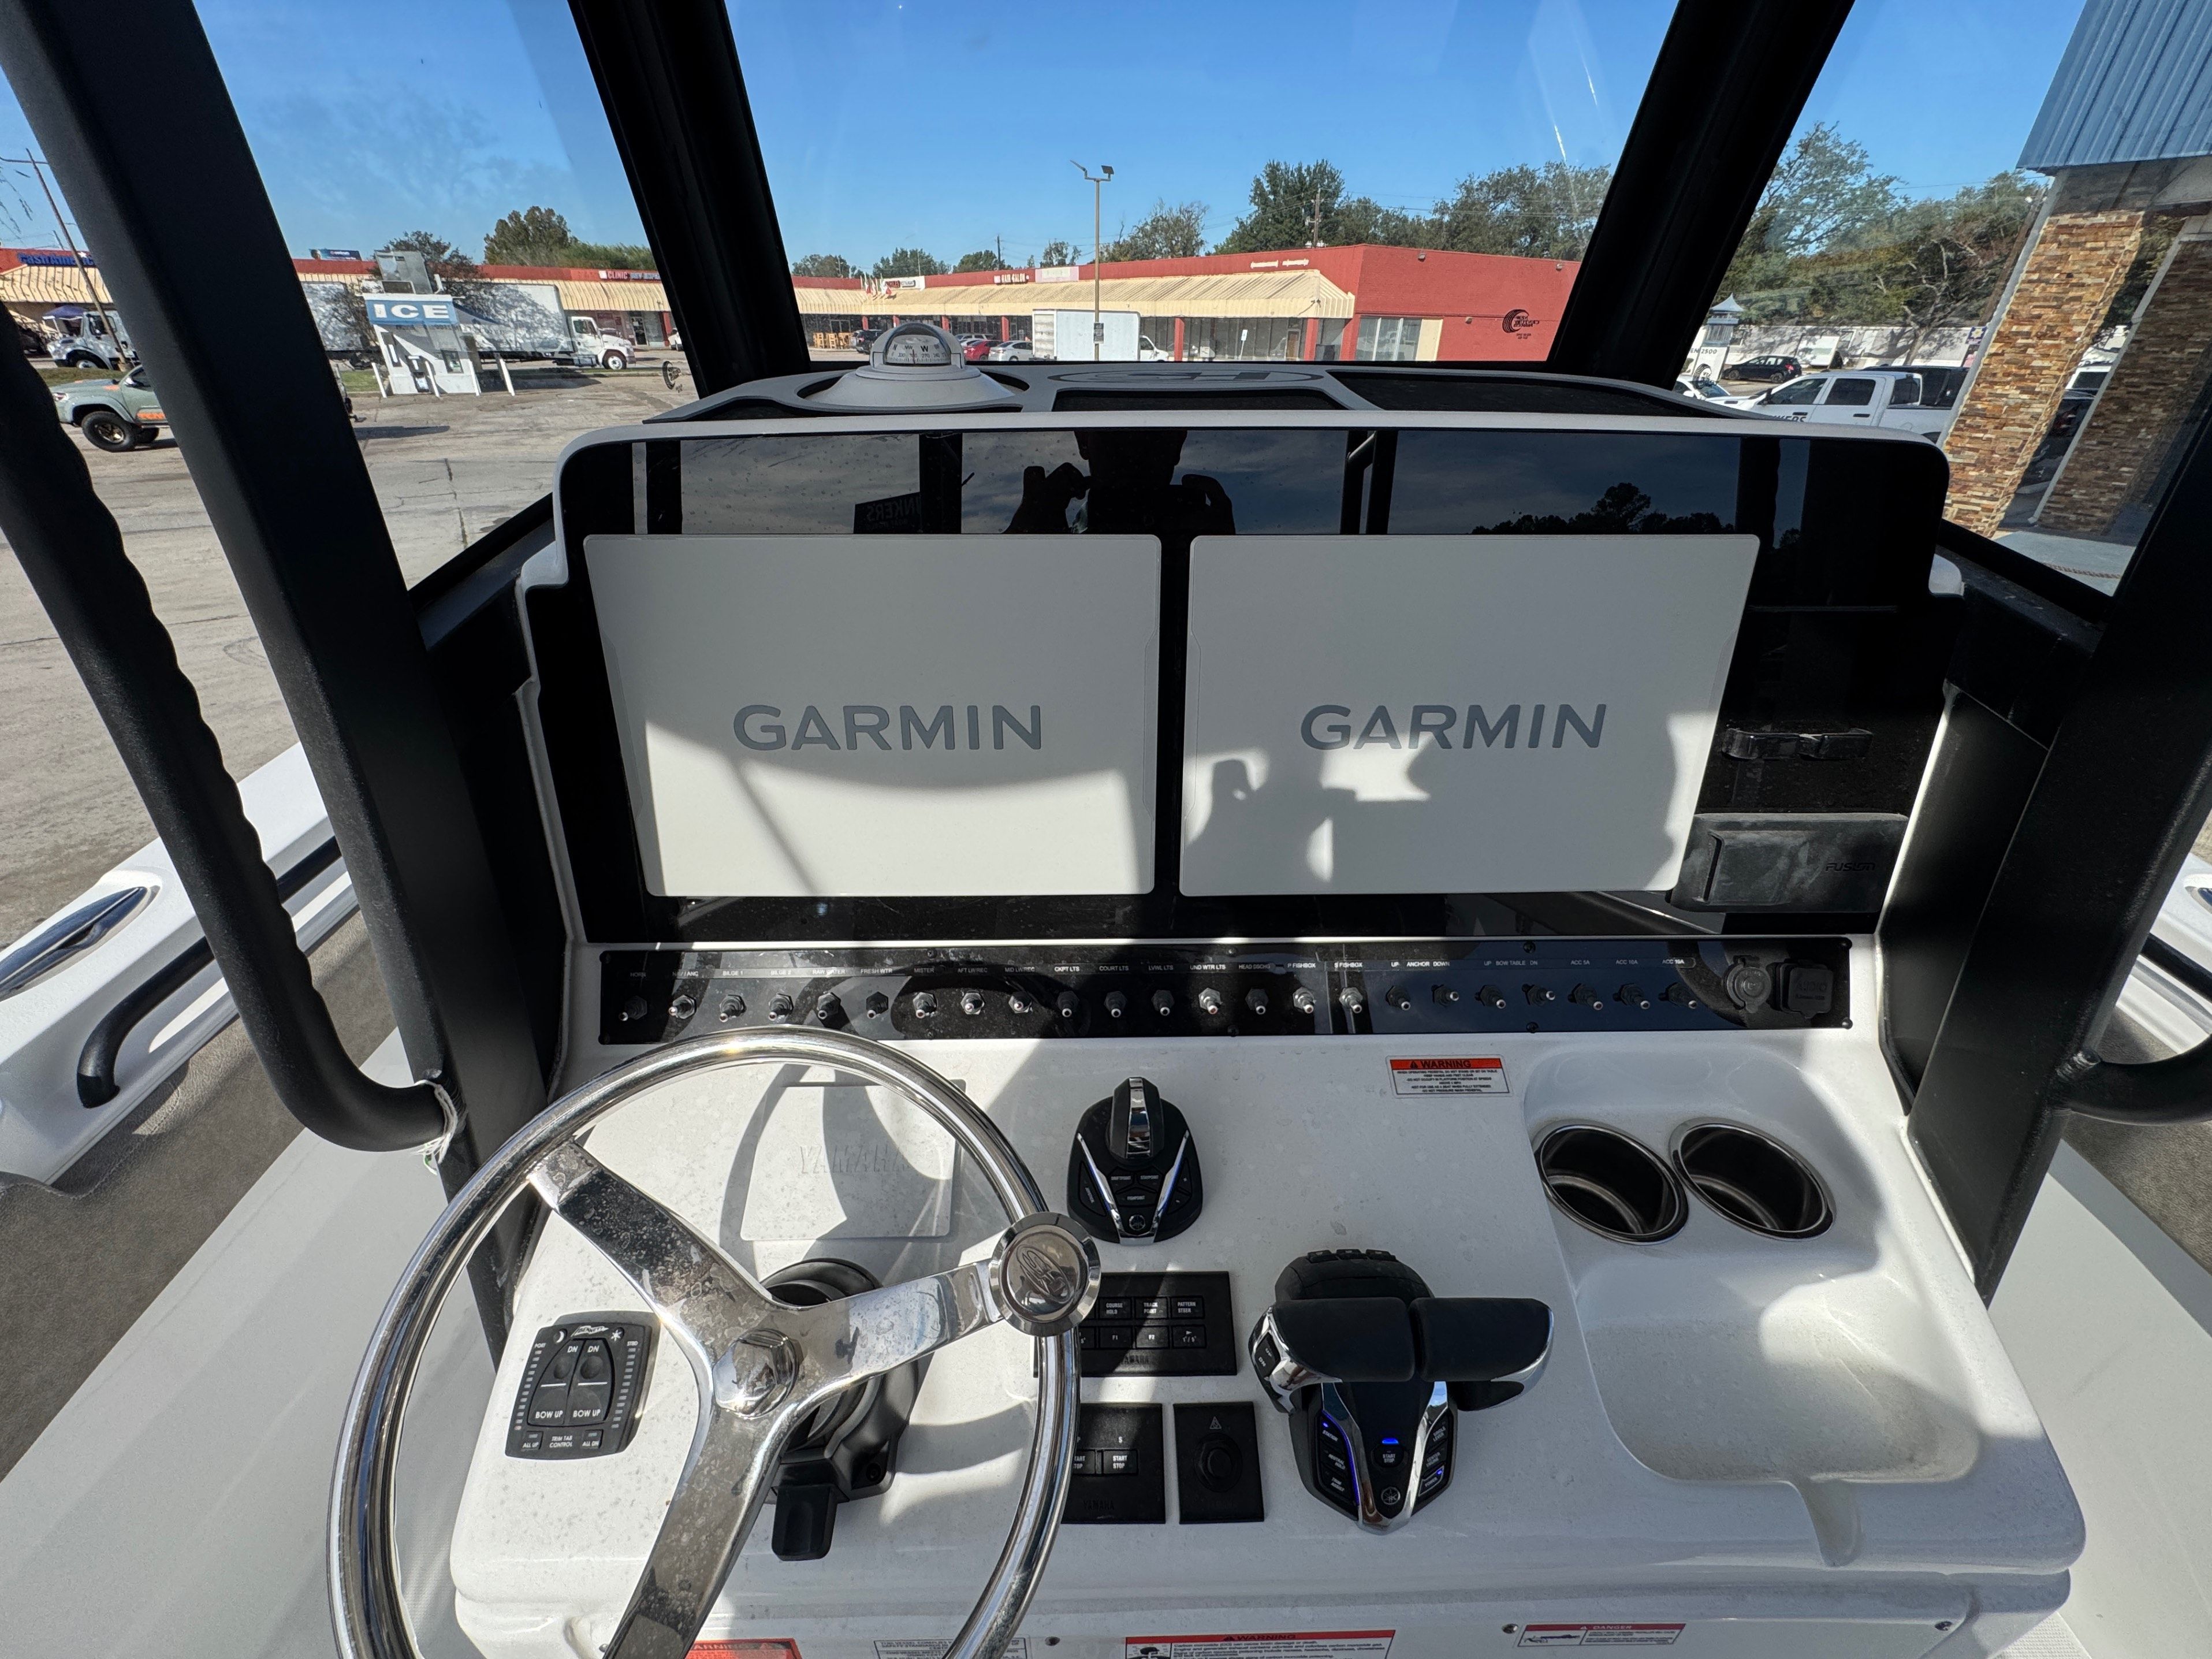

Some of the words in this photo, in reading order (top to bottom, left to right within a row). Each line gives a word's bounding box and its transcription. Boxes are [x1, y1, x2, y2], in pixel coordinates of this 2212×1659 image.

[608, 270, 628, 280] CLINIC
[373, 304, 449, 318] ICE
[733, 705, 1042, 751] GARMIN
[1302, 704, 1607, 750] GARMIN
[1421, 1060, 1472, 1068] WARNING
[554, 1410, 564, 1418] UP
[573, 1409, 591, 1418] BOW
[592, 1409, 601, 1417] UP
[1118, 1435, 1123, 1444] S
